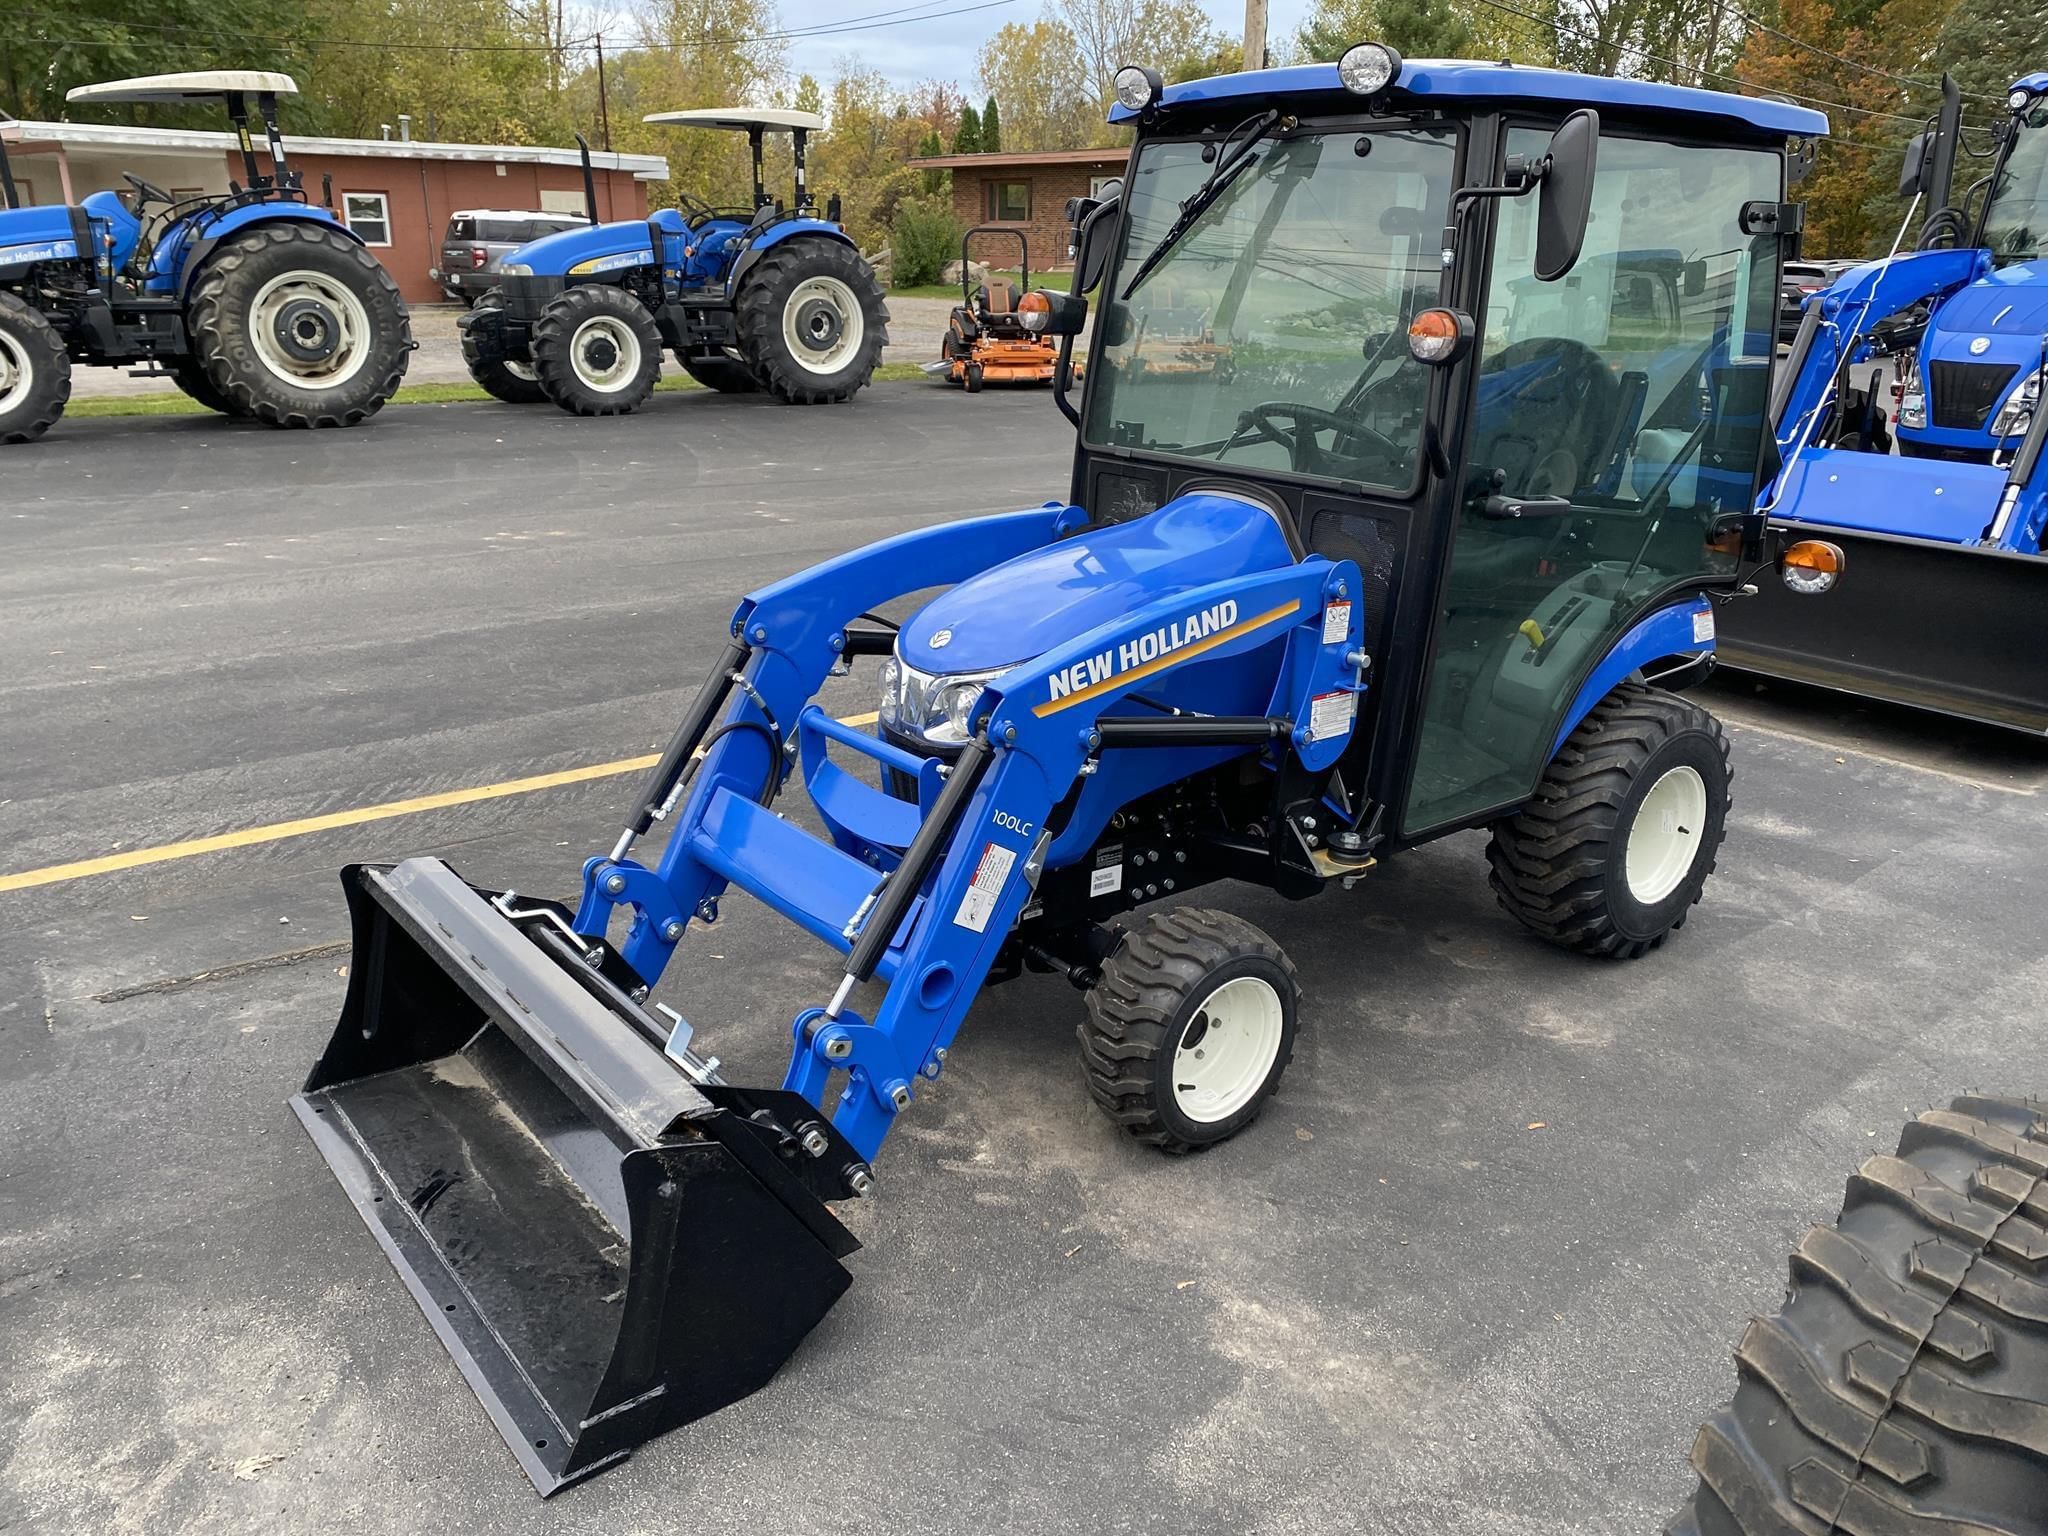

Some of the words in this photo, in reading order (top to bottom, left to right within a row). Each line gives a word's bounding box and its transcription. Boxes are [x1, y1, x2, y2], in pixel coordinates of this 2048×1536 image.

[15, 249, 52, 262] Holland
[1048, 650, 1113, 701] NEW
[1119, 600, 1237, 672] HOLLAND
[992, 809, 1032, 837] 100LC
